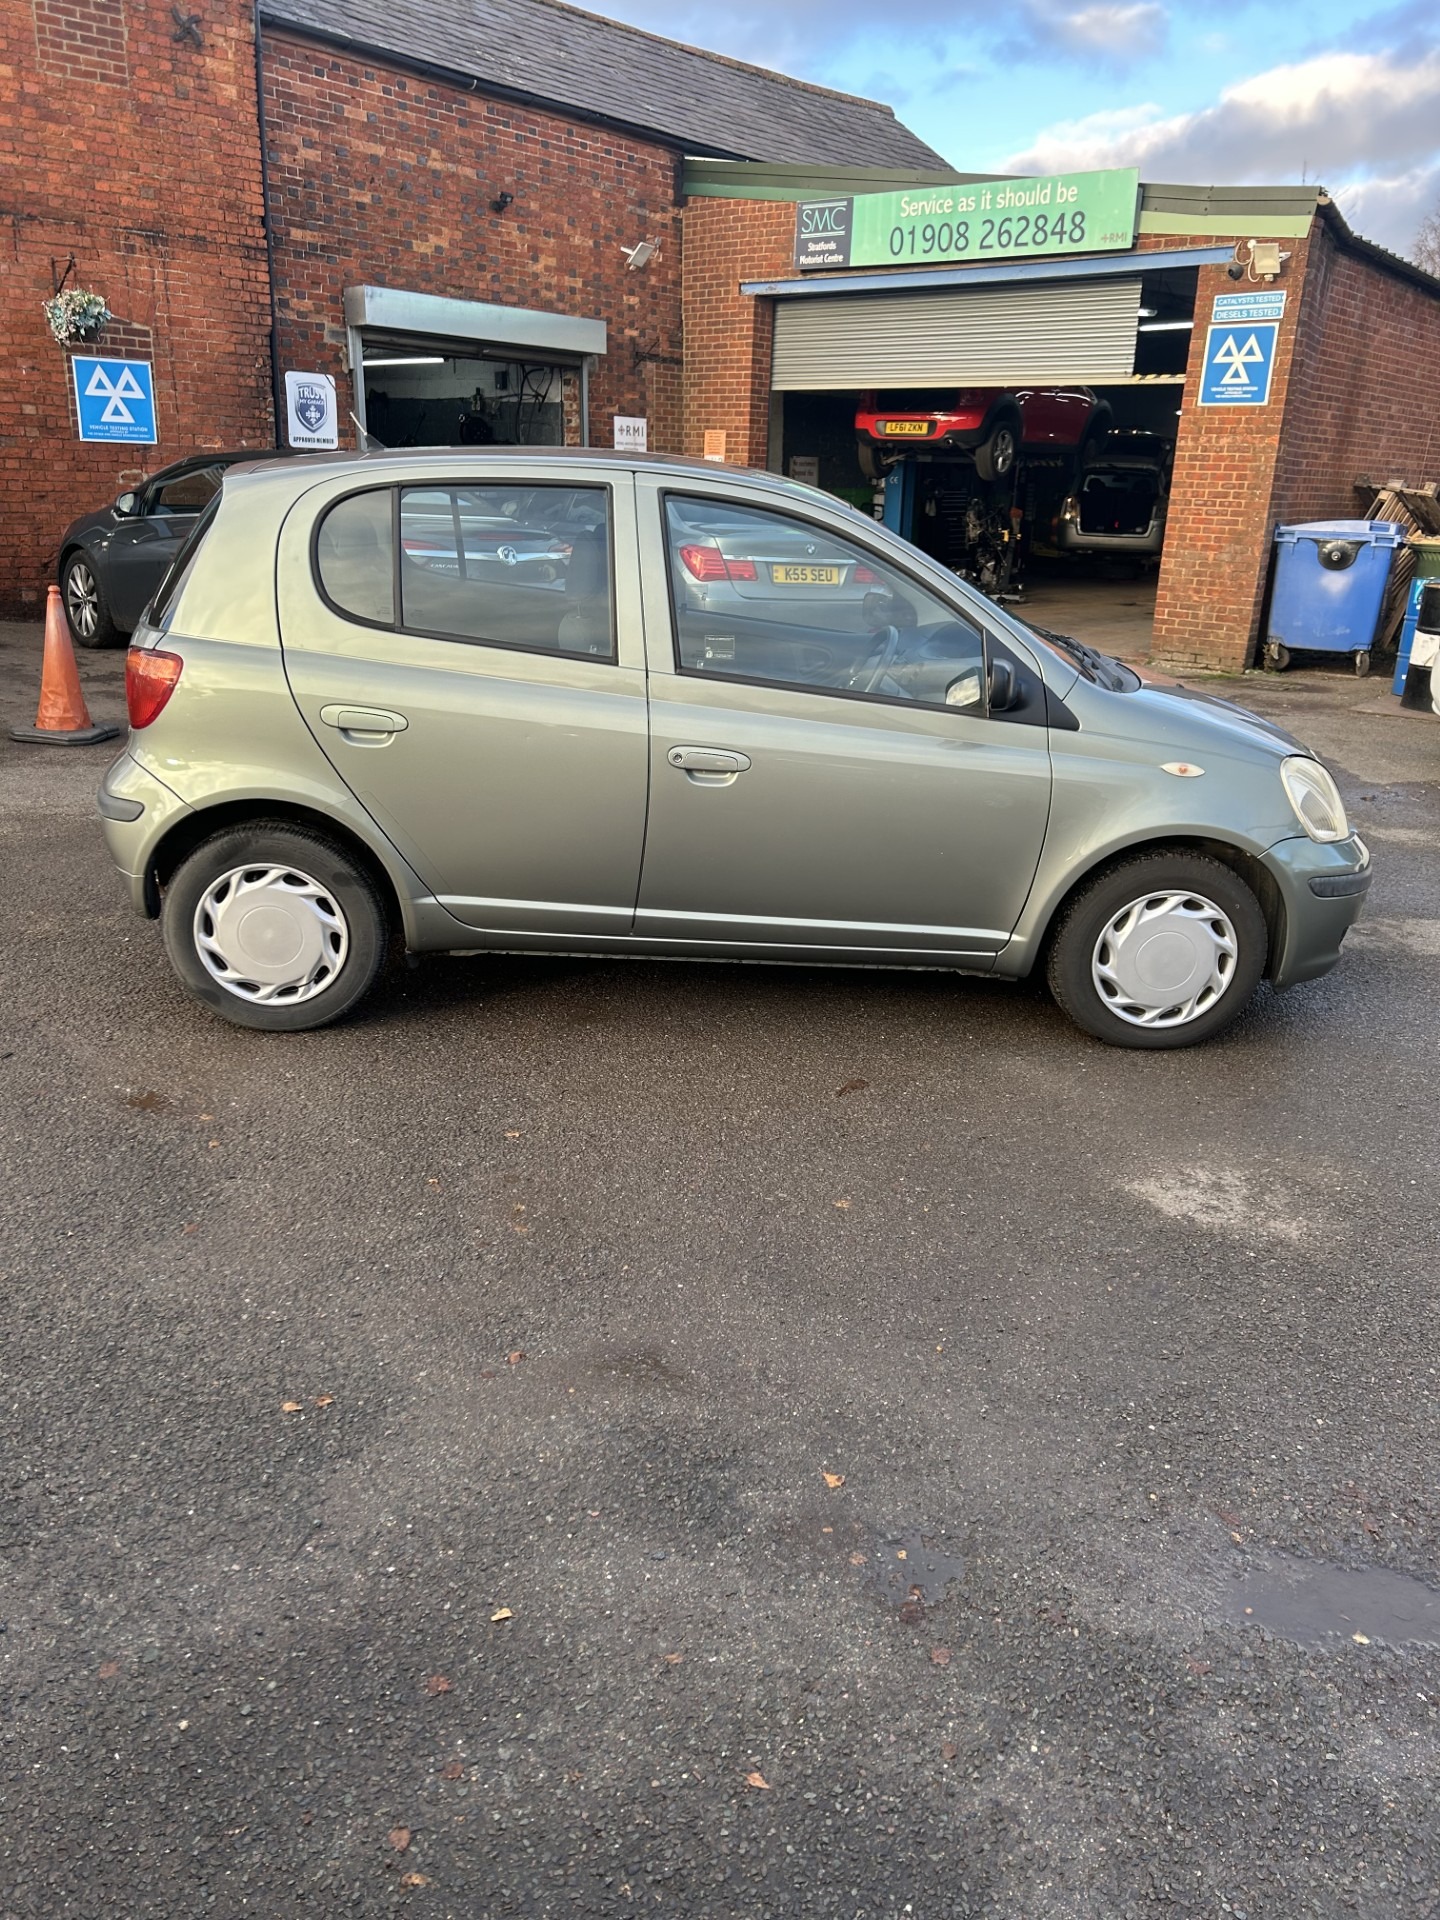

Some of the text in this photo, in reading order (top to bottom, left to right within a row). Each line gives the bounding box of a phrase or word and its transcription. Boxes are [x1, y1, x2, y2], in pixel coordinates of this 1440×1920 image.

[901, 182, 1078, 217] Service as it should be
[801, 207, 846, 233] SMC
[890, 211, 1086, 256] 01908 262848
[1108, 232, 1128, 244] RMI
[807, 241, 837, 252] Stratfords
[799, 253, 844, 265] Motorist Centre
[1218, 295, 1281, 305] CATALYSTS TESTED
[1216, 308, 1278, 319] DIESELS TESTED
[626, 425, 644, 437] RMI
[811, 568, 833, 582] SEU
